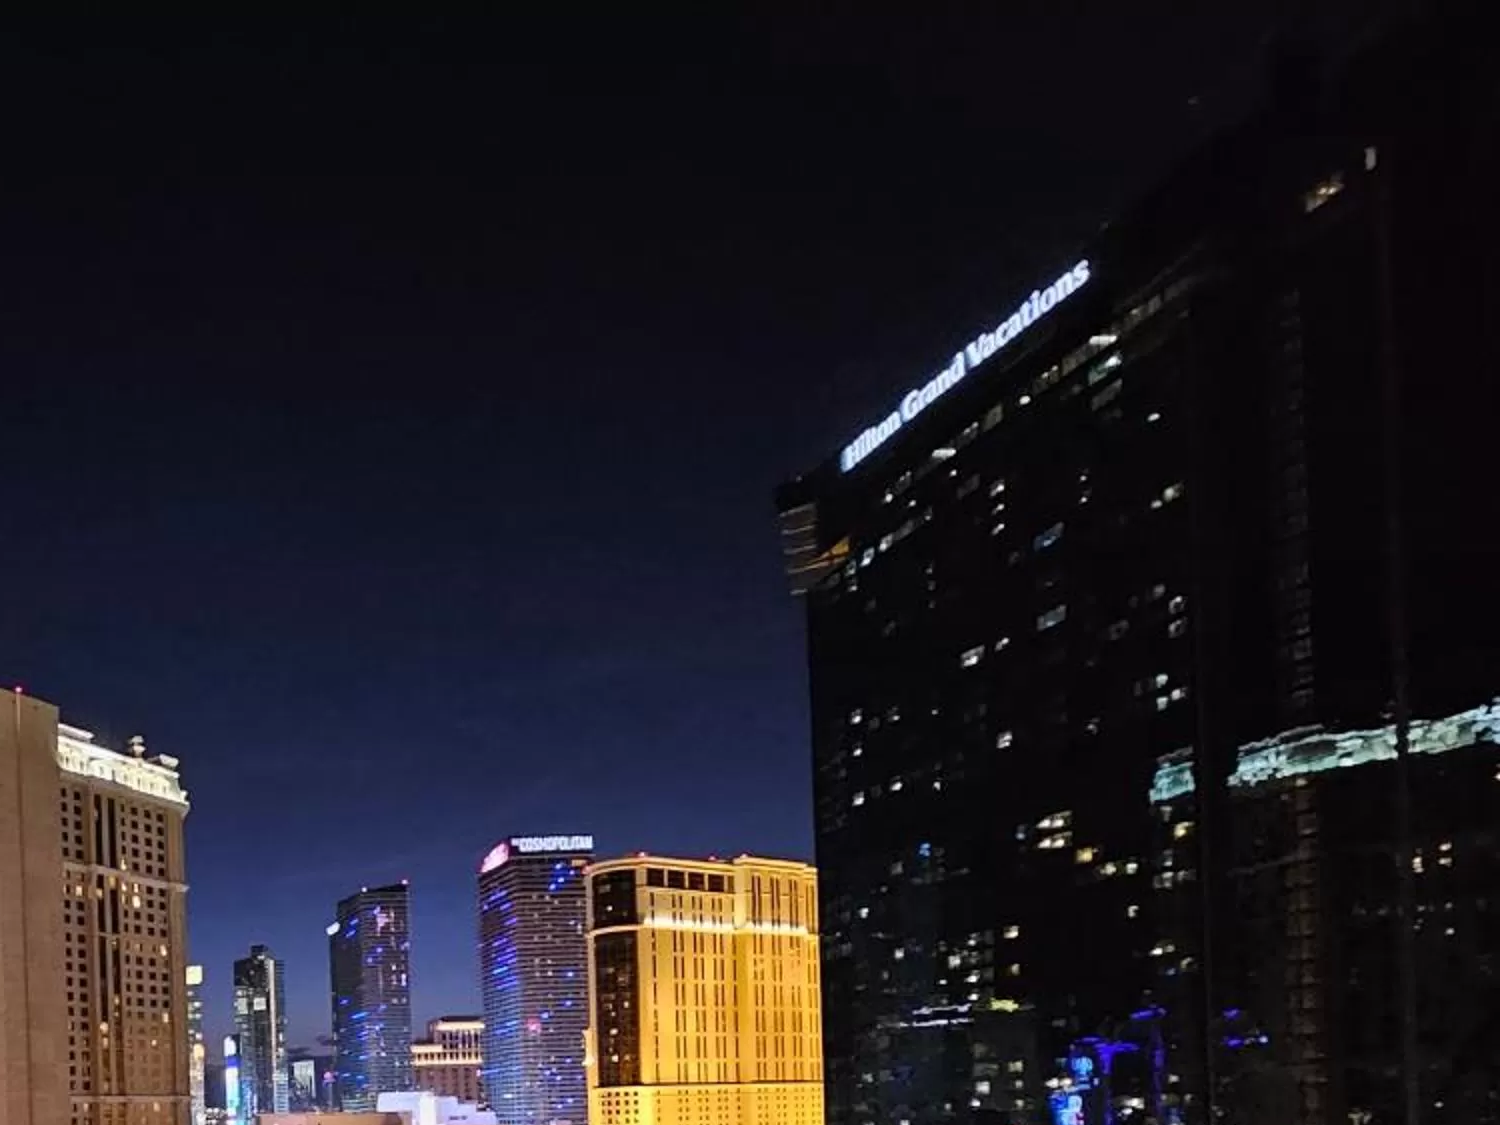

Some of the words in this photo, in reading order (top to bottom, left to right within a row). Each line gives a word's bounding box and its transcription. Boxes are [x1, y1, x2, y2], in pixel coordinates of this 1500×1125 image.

[840, 410, 902, 474] Hilton
[900, 351, 966, 424] Grand
[965, 259, 1091, 370] Vacations
